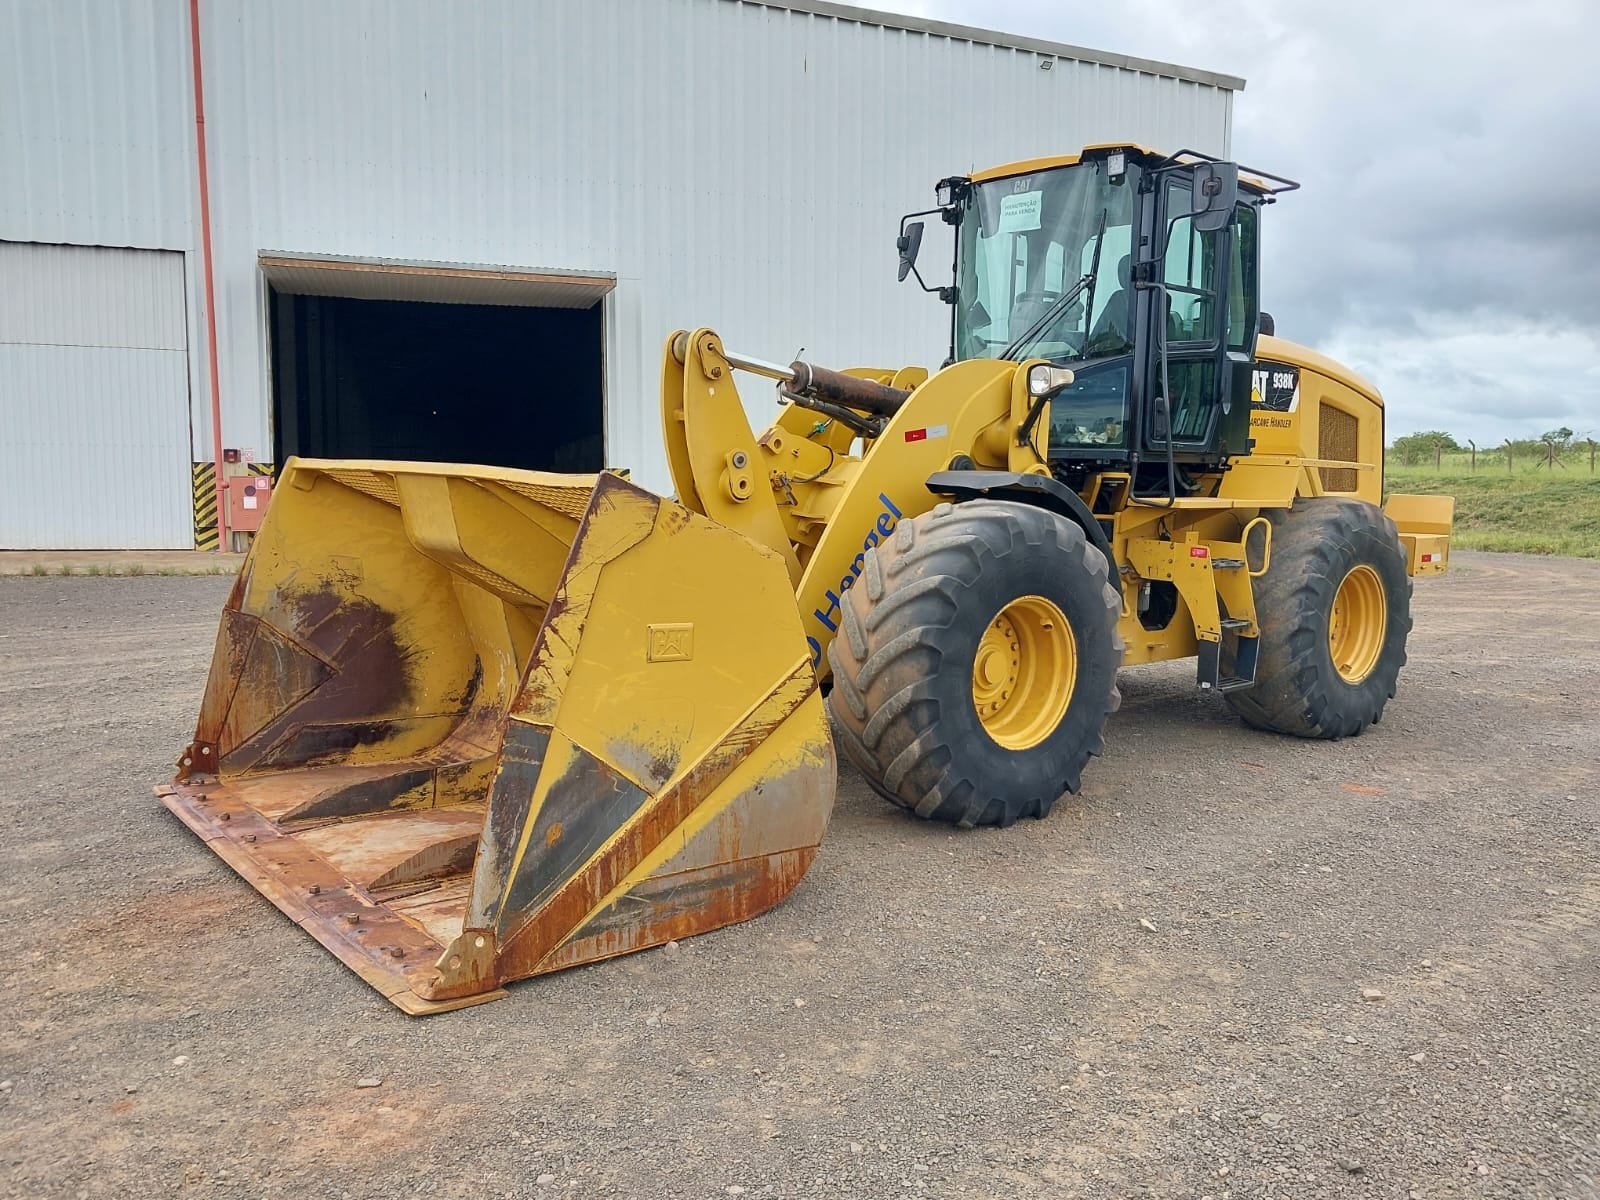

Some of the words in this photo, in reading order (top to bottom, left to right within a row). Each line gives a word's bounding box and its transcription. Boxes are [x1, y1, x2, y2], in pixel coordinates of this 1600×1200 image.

[1014, 178, 1032, 193] CAT
[1005, 200, 1037, 209] MANUTENÇÃO
[1251, 369, 1269, 402] AT
[1273, 372, 1294, 389] 938K
[1250, 417, 1270, 427] ARCANE
